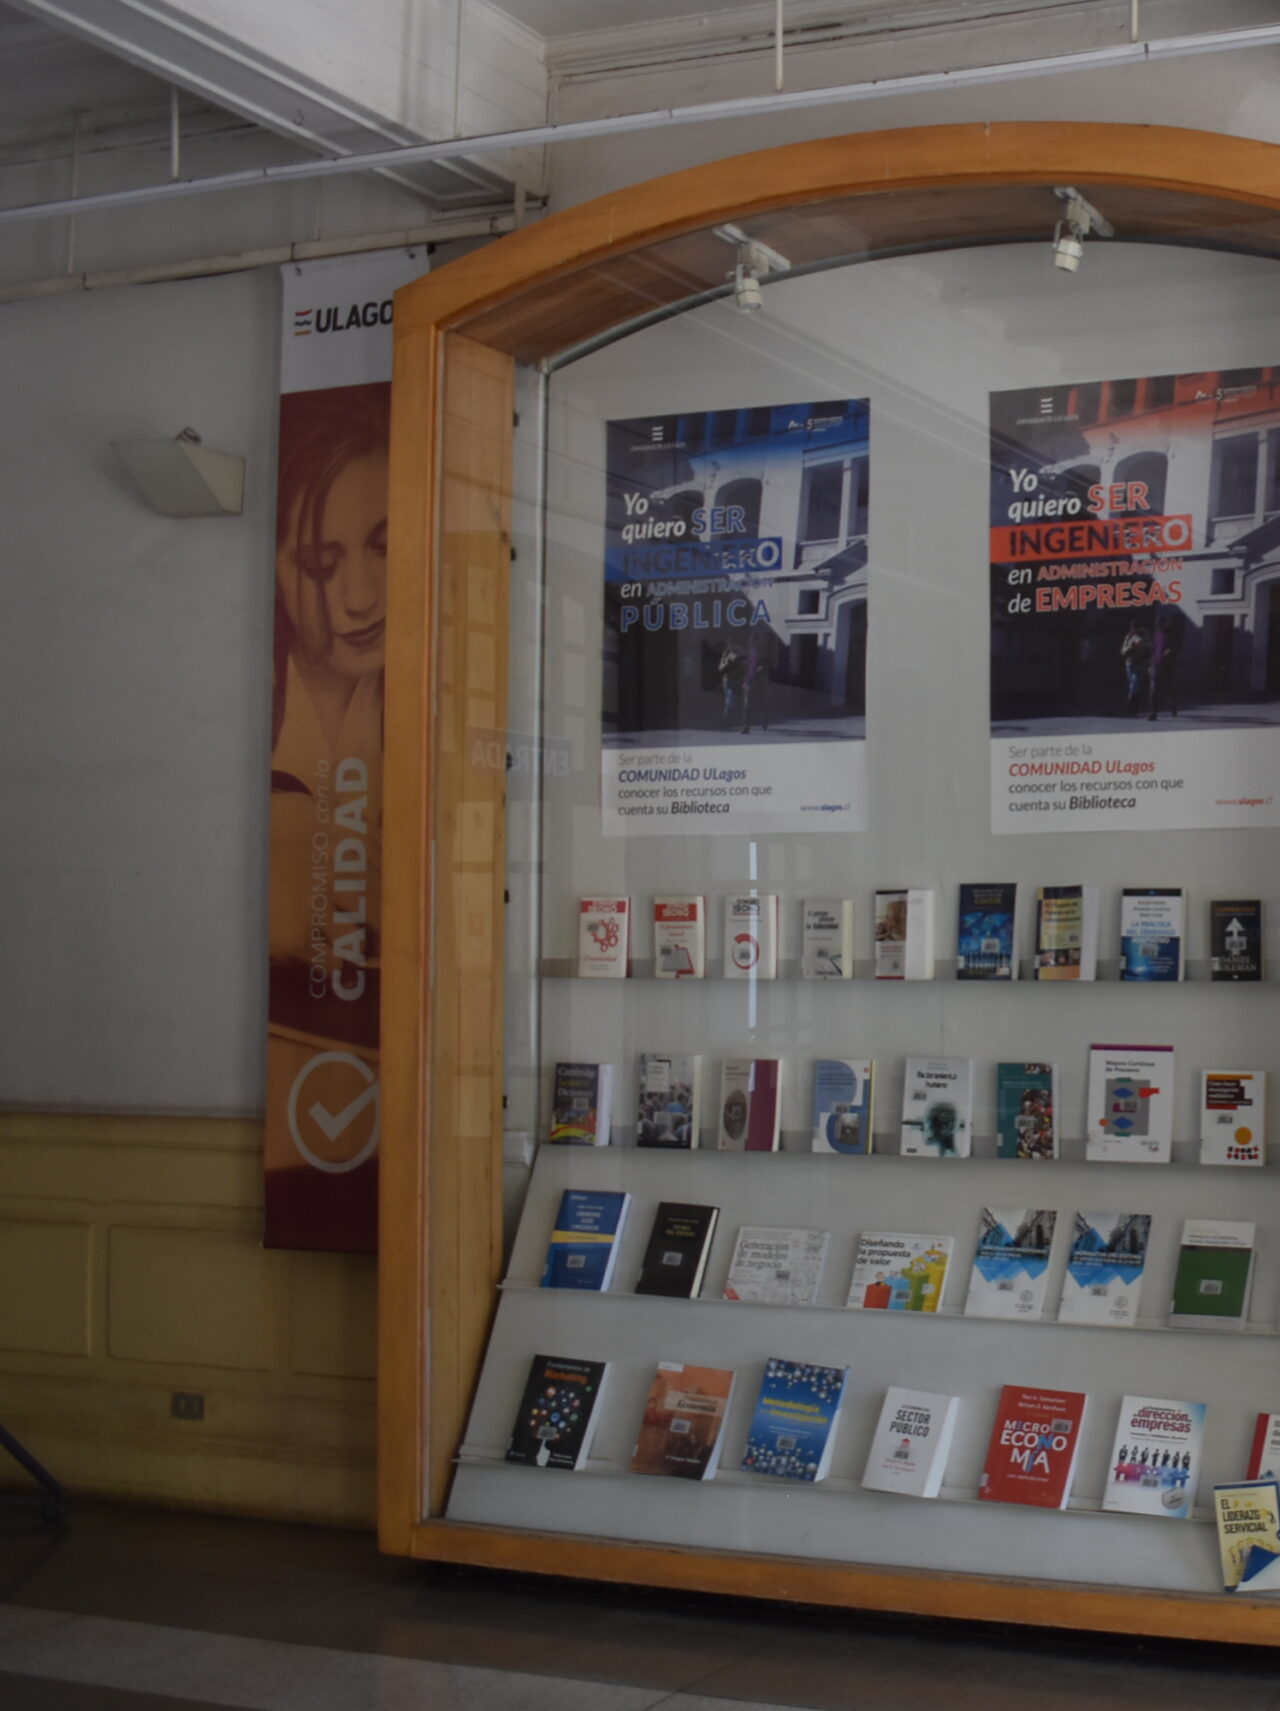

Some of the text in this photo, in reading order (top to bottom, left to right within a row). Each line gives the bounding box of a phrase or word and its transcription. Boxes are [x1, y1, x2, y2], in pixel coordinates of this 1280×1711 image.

[1009, 468, 1038, 492] Yo
[623, 492, 648, 515] Yo
[1008, 481, 1150, 523] quiero SER
[622, 505, 747, 544] quiero SER
[1009, 519, 1189, 556] INGENIERO
[622, 541, 780, 574] INGENIERO
[1008, 557, 1183, 585] en ADMINISTRACIÓN
[621, 582, 641, 598] en
[1008, 580, 1182, 613] de EMPRESAS
[621, 597, 771, 632] PÚBLICA
[618, 752, 692, 766] Ser parte de la
[1009, 744, 1092, 760] Ser parte de la
[618, 768, 746, 783] COMUNIDAD ULagos
[1009, 760, 1155, 777] COMUNIDAD ULagos
[618, 786, 772, 799] conocer los recursos con que
[1008, 779, 1184, 794] conocer los recursos con que
[618, 801, 730, 816] cuenta su Biblioteca
[1008, 796, 1136, 812] cuenta su Biblioteca
[309, 759, 329, 999] COMPROMISO con la
[331, 757, 368, 1001] CALIDAD
[861, 1239, 905, 1248] Diseñando
[857, 1256, 891, 1265] de valor
[868, 1249, 911, 1258] propuesta
[896, 1409, 931, 1425] SECTOR
[1138, 1408, 1188, 1421] dirección
[1004, 1419, 1050, 1433] MICRO
[1131, 1417, 1191, 1433] empresas
[1000, 1430, 1068, 1451] ECONO
[1221, 1499, 1231, 1509] EL
[1224, 1522, 1268, 1534] SERVICIAL
